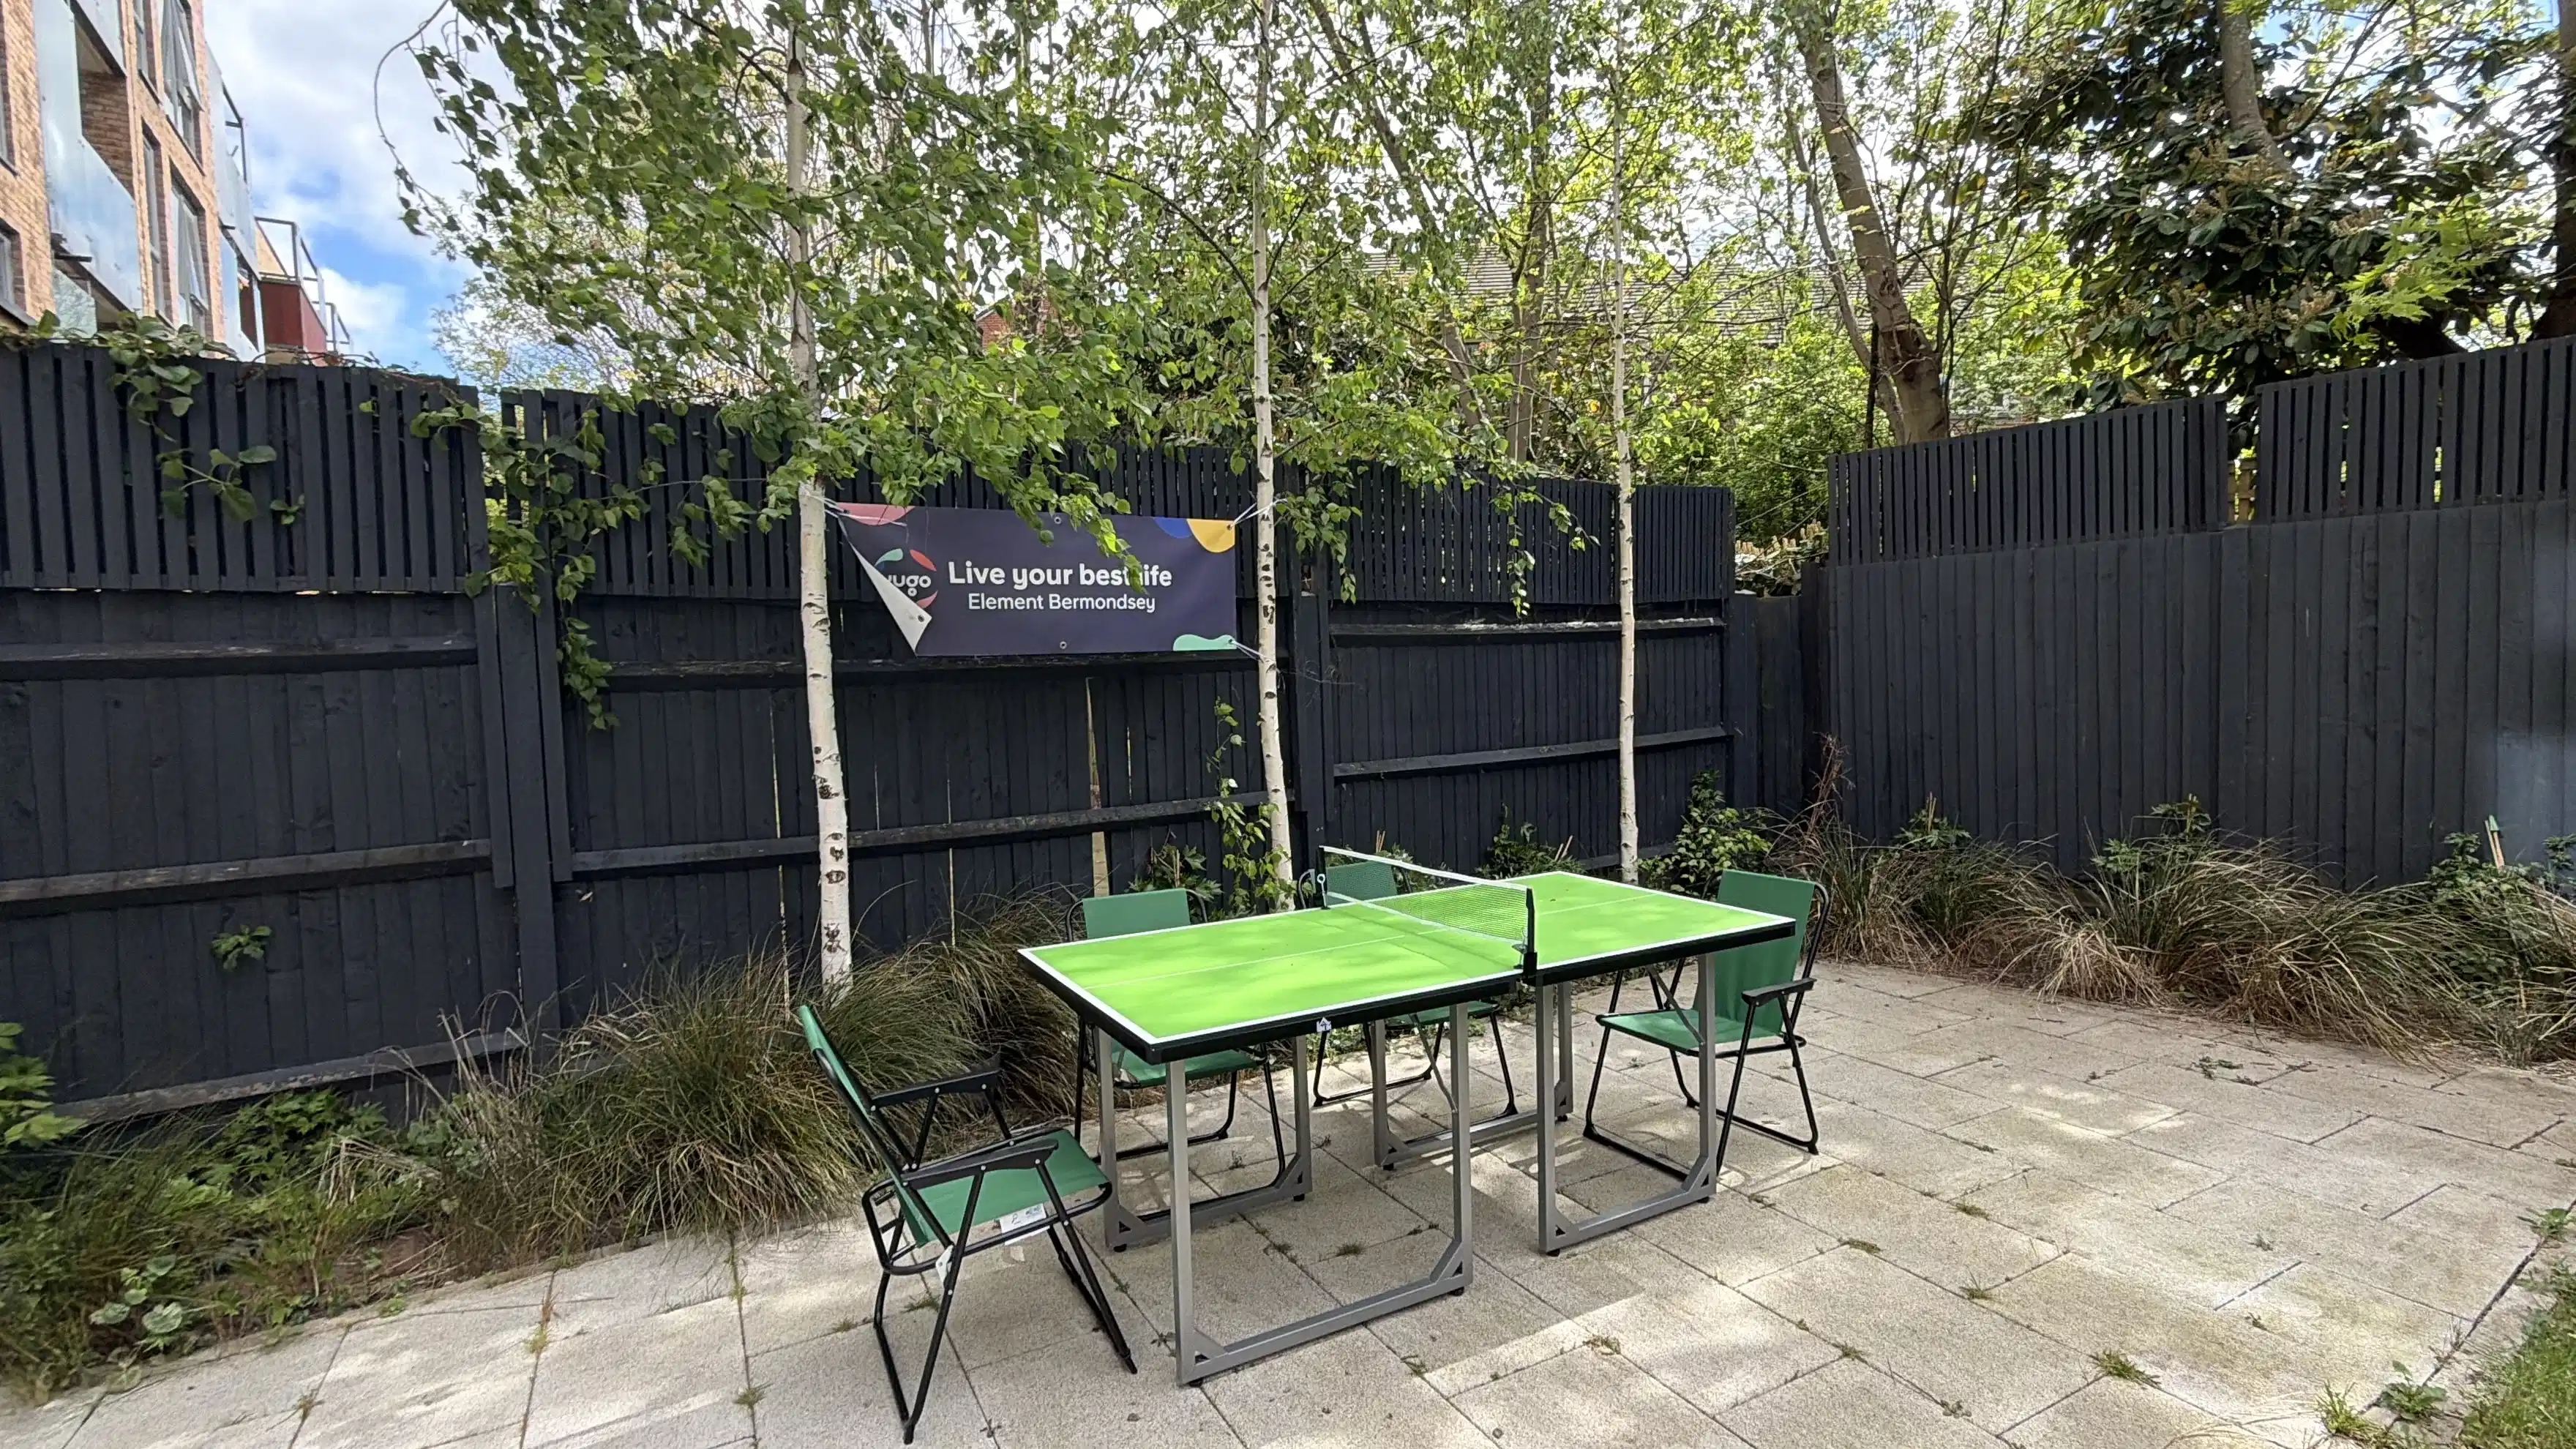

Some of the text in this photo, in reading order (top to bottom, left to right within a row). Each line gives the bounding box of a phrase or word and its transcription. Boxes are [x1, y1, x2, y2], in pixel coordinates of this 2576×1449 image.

[948, 561, 1006, 584] Live
[1012, 568, 1073, 590] your
[1079, 563, 1130, 585] best
[968, 593, 1156, 613] Element Bermondsey
